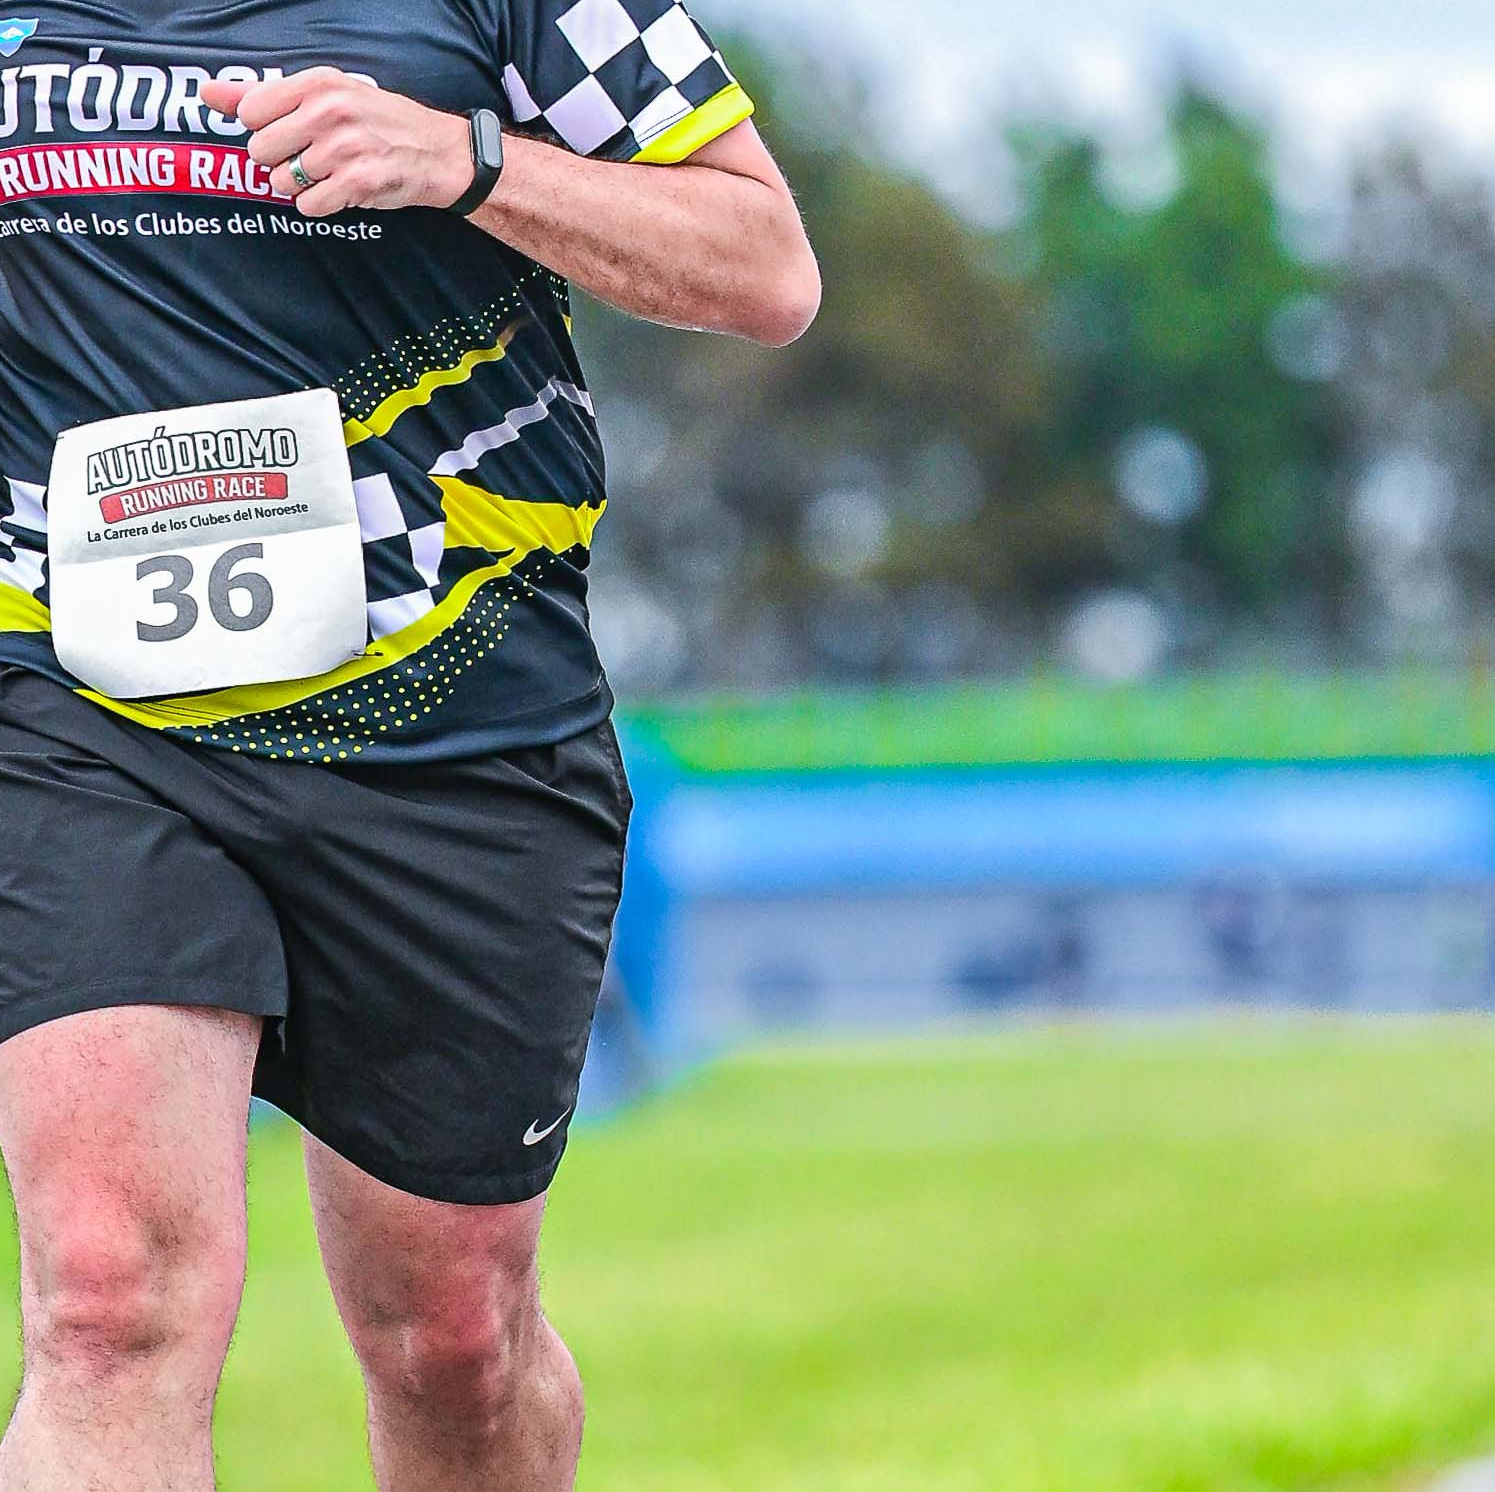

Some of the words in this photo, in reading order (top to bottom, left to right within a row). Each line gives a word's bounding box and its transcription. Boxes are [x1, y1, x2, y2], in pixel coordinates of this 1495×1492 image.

[190, 149, 292, 200] RAC
[56, 212, 88, 235] de
[92, 213, 129, 236] los
[135, 212, 221, 236] Clubes
[227, 213, 265, 235] del
[270, 215, 382, 240] Noroeste
[87, 426, 299, 495] AUTÓDROMO
[119, 480, 208, 517] RUNNING
[212, 476, 266, 499] RACE
[87, 530, 102, 543] La
[103, 526, 149, 541] Carrera
[151, 521, 167, 534] de
[169, 517, 188, 531] los
[190, 512, 232, 529] Clubes
[233, 508, 253, 523] del
[254, 502, 309, 520] Noroeste
[136, 542, 274, 643] 36
